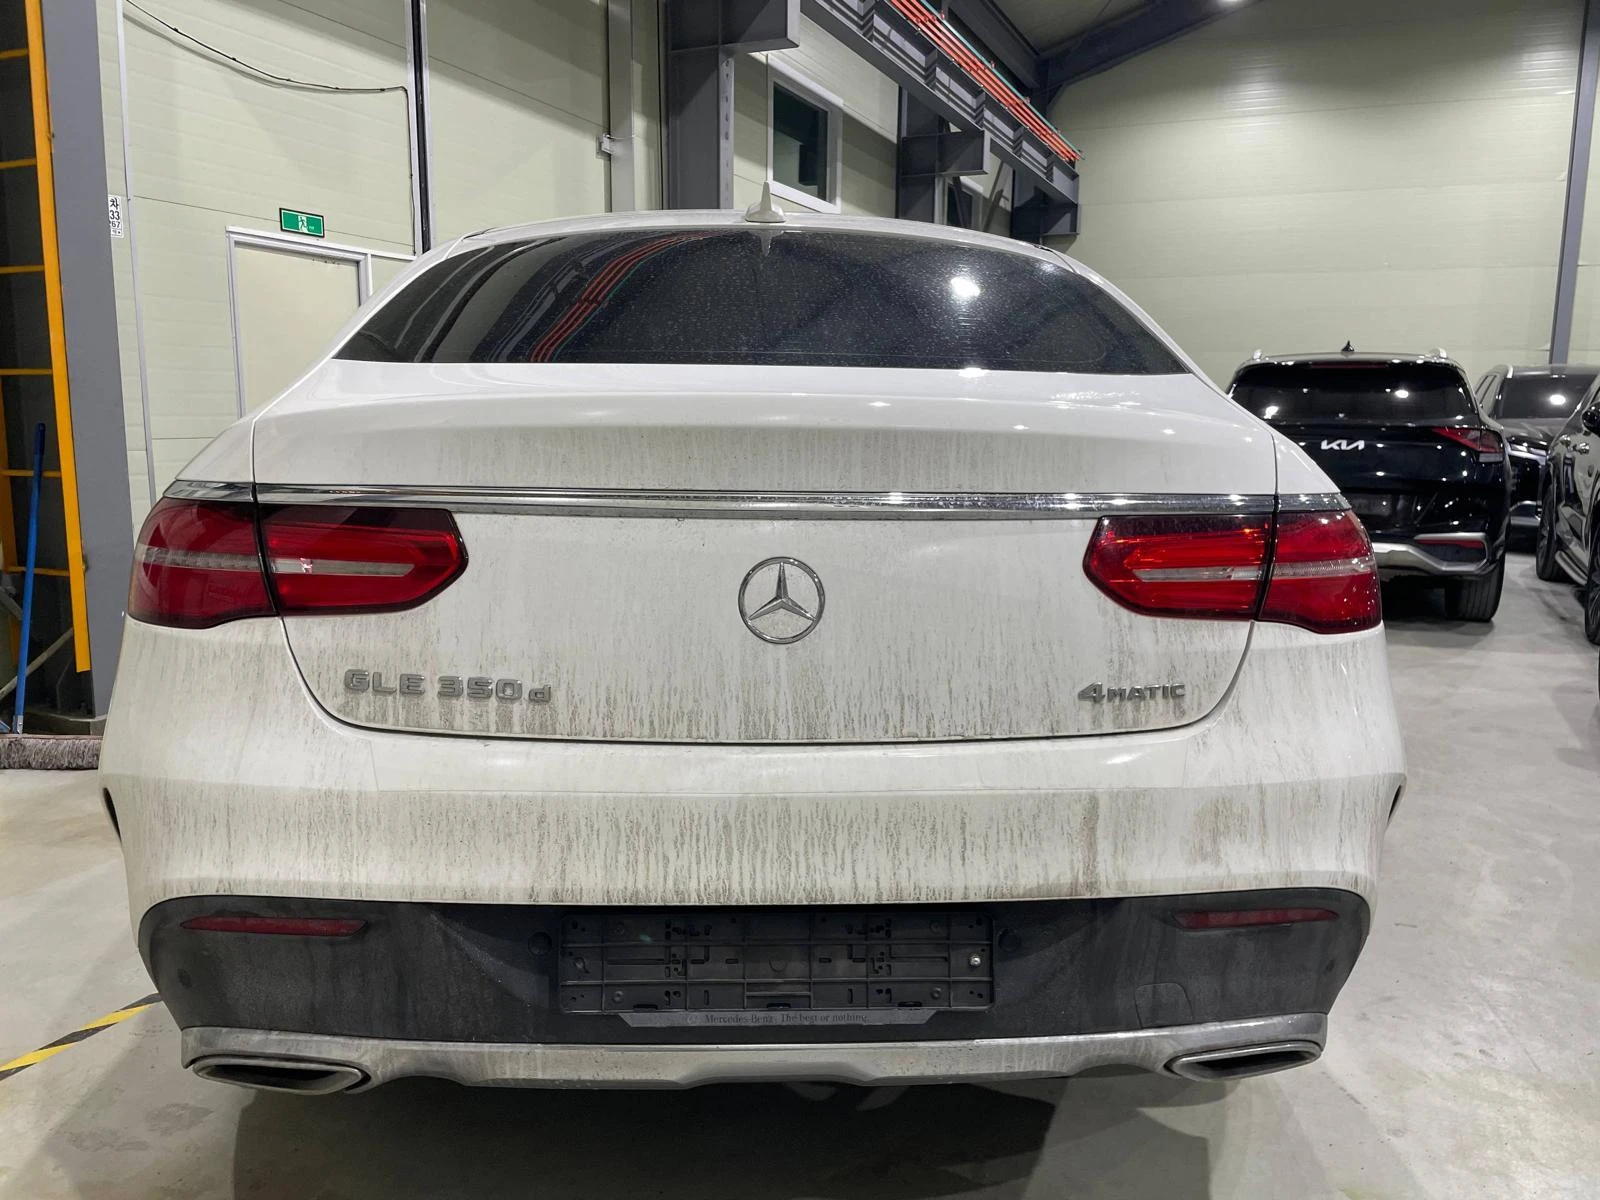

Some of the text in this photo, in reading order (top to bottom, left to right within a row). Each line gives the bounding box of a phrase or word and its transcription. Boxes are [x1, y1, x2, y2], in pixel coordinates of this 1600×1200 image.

[1321, 439, 1365, 451] KIA
[344, 669, 551, 702] GLE 350 d
[1078, 681, 1185, 702] 4MATIC
[781, 1012, 799, 1023] The
